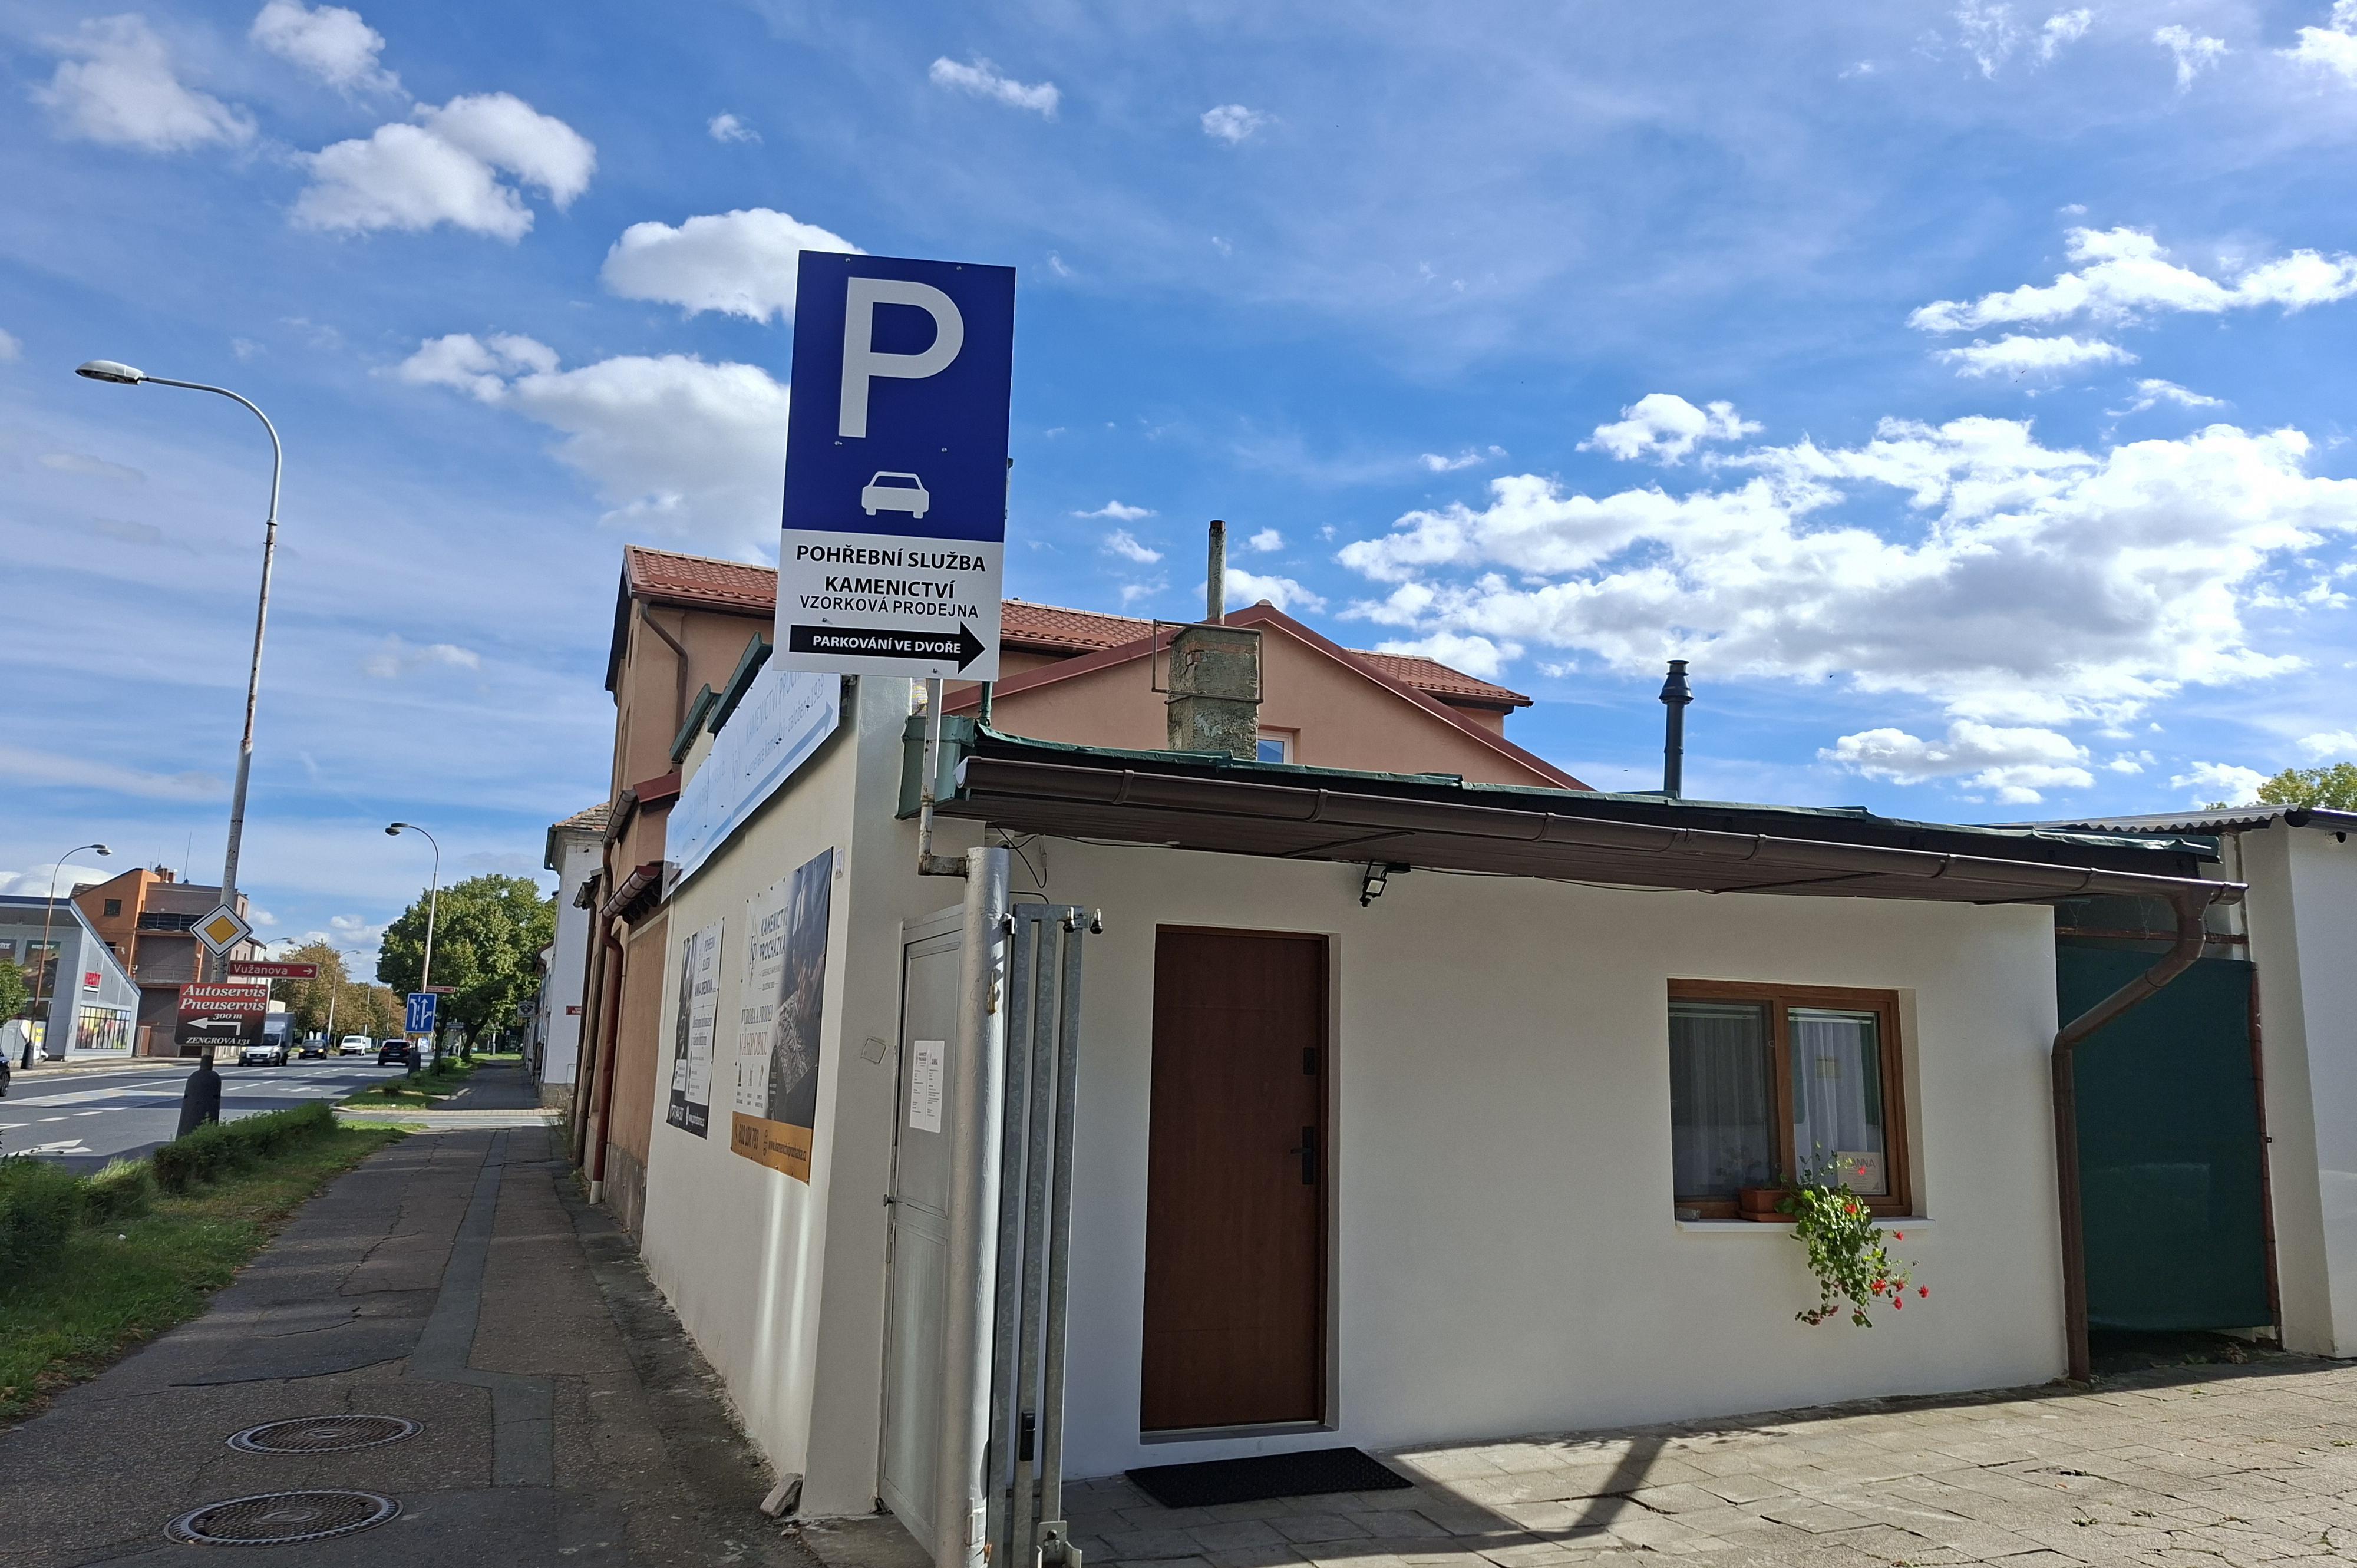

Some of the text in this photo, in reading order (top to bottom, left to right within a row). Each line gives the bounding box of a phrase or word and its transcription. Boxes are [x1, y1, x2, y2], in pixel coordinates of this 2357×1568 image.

[838, 276, 965, 438] P
[796, 544, 986, 572] POHŘEBNÍ SLUŽBA
[825, 575, 956, 599] KAMENICTVÍ
[799, 595, 979, 618] VZORKOVÁ PRODEJNA
[813, 635, 962, 653] PARKOVÁNÍ VE DVOŘE
[810, 673, 824, 708] 1929
[760, 900, 789, 937] KAMENICTVÍ
[759, 931, 786, 962] PROCHÁZKA
[233, 963, 288, 975] Vužanova
[181, 984, 266, 998] Autoservis
[179, 998, 265, 1011] Pneuservis
[186, 1036, 236, 1045] ZENGROVA
[740, 1025, 768, 1055] NÁHROBKŮ
